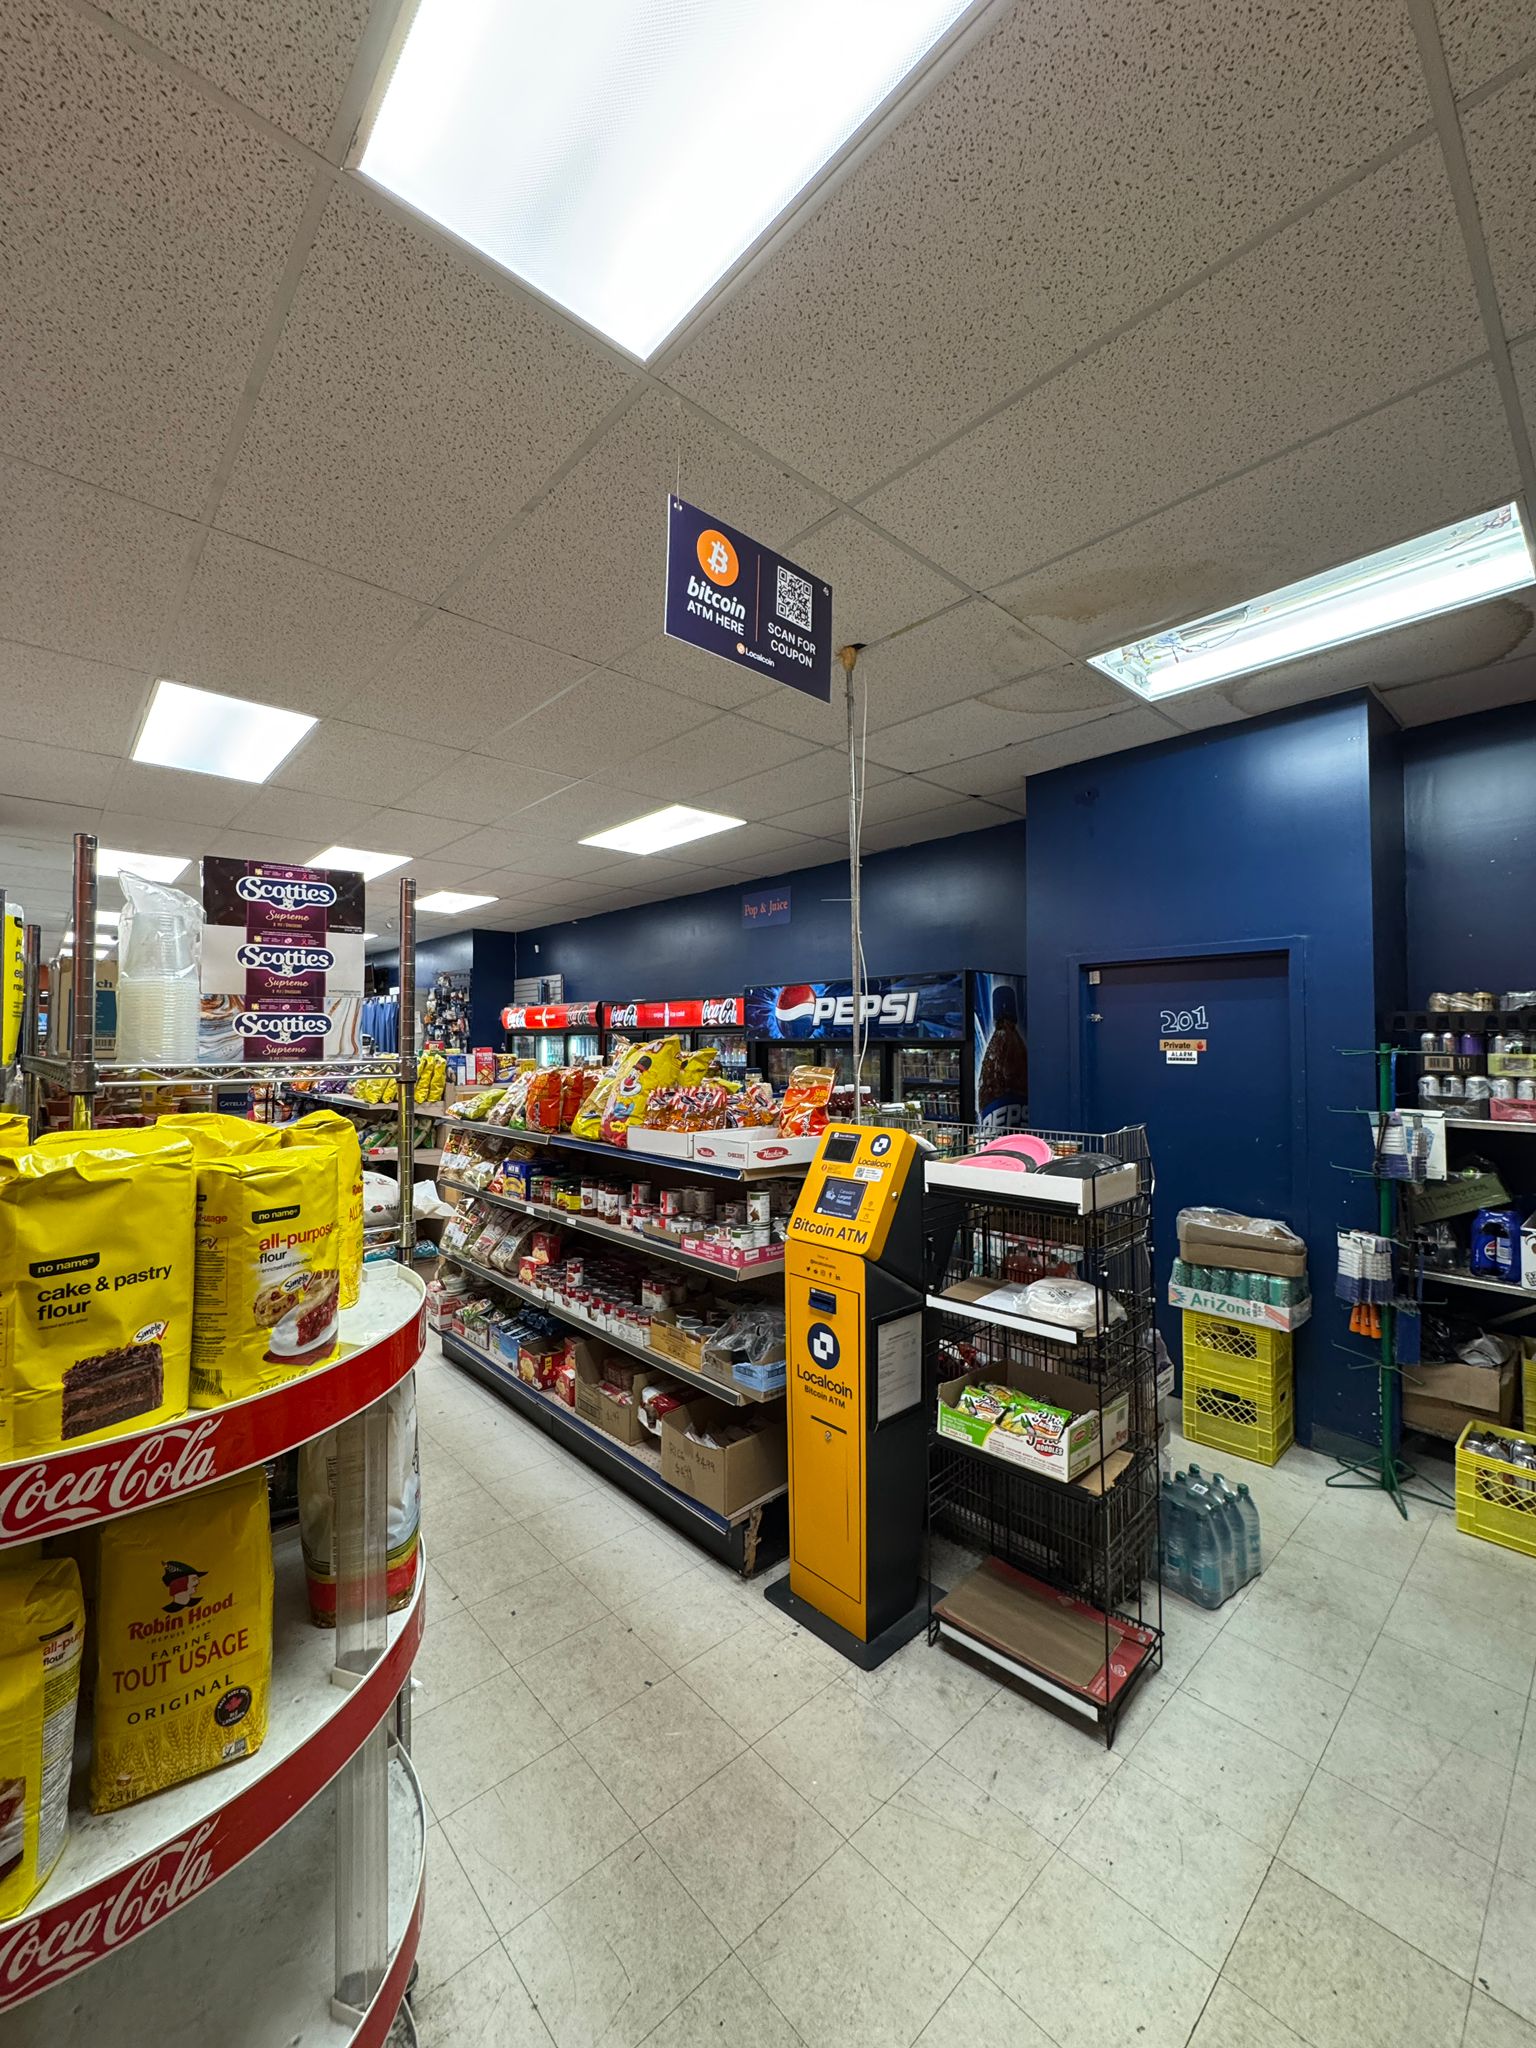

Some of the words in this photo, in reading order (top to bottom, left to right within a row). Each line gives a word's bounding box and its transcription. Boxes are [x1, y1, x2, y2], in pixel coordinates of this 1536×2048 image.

[687, 576, 746, 620] bitcoin
[687, 600, 713, 622] ATM
[715, 611, 745, 636] HERE
[767, 622, 796, 645] SCAN
[797, 637, 816, 655] FOR
[745, 647, 775, 667] Localcoin
[770, 639, 813, 668] COUPON
[242, 877, 331, 902] Scotties
[265, 909, 310, 921] Supreme
[744, 904, 758, 919] Pop
[760, 902, 766, 913] &
[768, 898, 788, 916] Juice
[241, 945, 330, 968] Scotties
[264, 976, 309, 988] Supreme
[812, 991, 919, 1026] PEPSI
[1160, 1005, 1209, 1033] 201
[238, 1013, 328, 1036] Scotties
[262, 1044, 307, 1056] Supreme
[857, 1157, 892, 1169] Localcoin
[258, 1212, 270, 1221] no
[271, 1209, 294, 1219] name
[793, 1217, 835, 1238] Bitcoin
[836, 1227, 868, 1245] ATM
[37, 1264, 54, 1274] no
[56, 1258, 89, 1271] name
[259, 1251, 288, 1264] flour
[37, 1282, 91, 1303] cake
[95, 1275, 110, 1292] &
[114, 1265, 172, 1291] pastry
[37, 1300, 91, 1321] flour
[797, 1364, 853, 1400] Localcoin
[804, 1384, 828, 1401] Bitcoin
[829, 1395, 846, 1409] ATM
[1036, 1442, 1064, 1457] NOODLES
[0, 1415, 224, 1538] Coca-Cola
[128, 1614, 184, 1641] Robin
[188, 1592, 234, 1625] Hood
[43, 1651, 66, 1666] flour
[151, 1631, 211, 1661] FARINE
[112, 1660, 171, 1694] TOUT
[179, 1628, 249, 1675] USAGE
[127, 1674, 234, 1725] ORIGINAL
[0, 1814, 221, 2001] Coca-Cola
